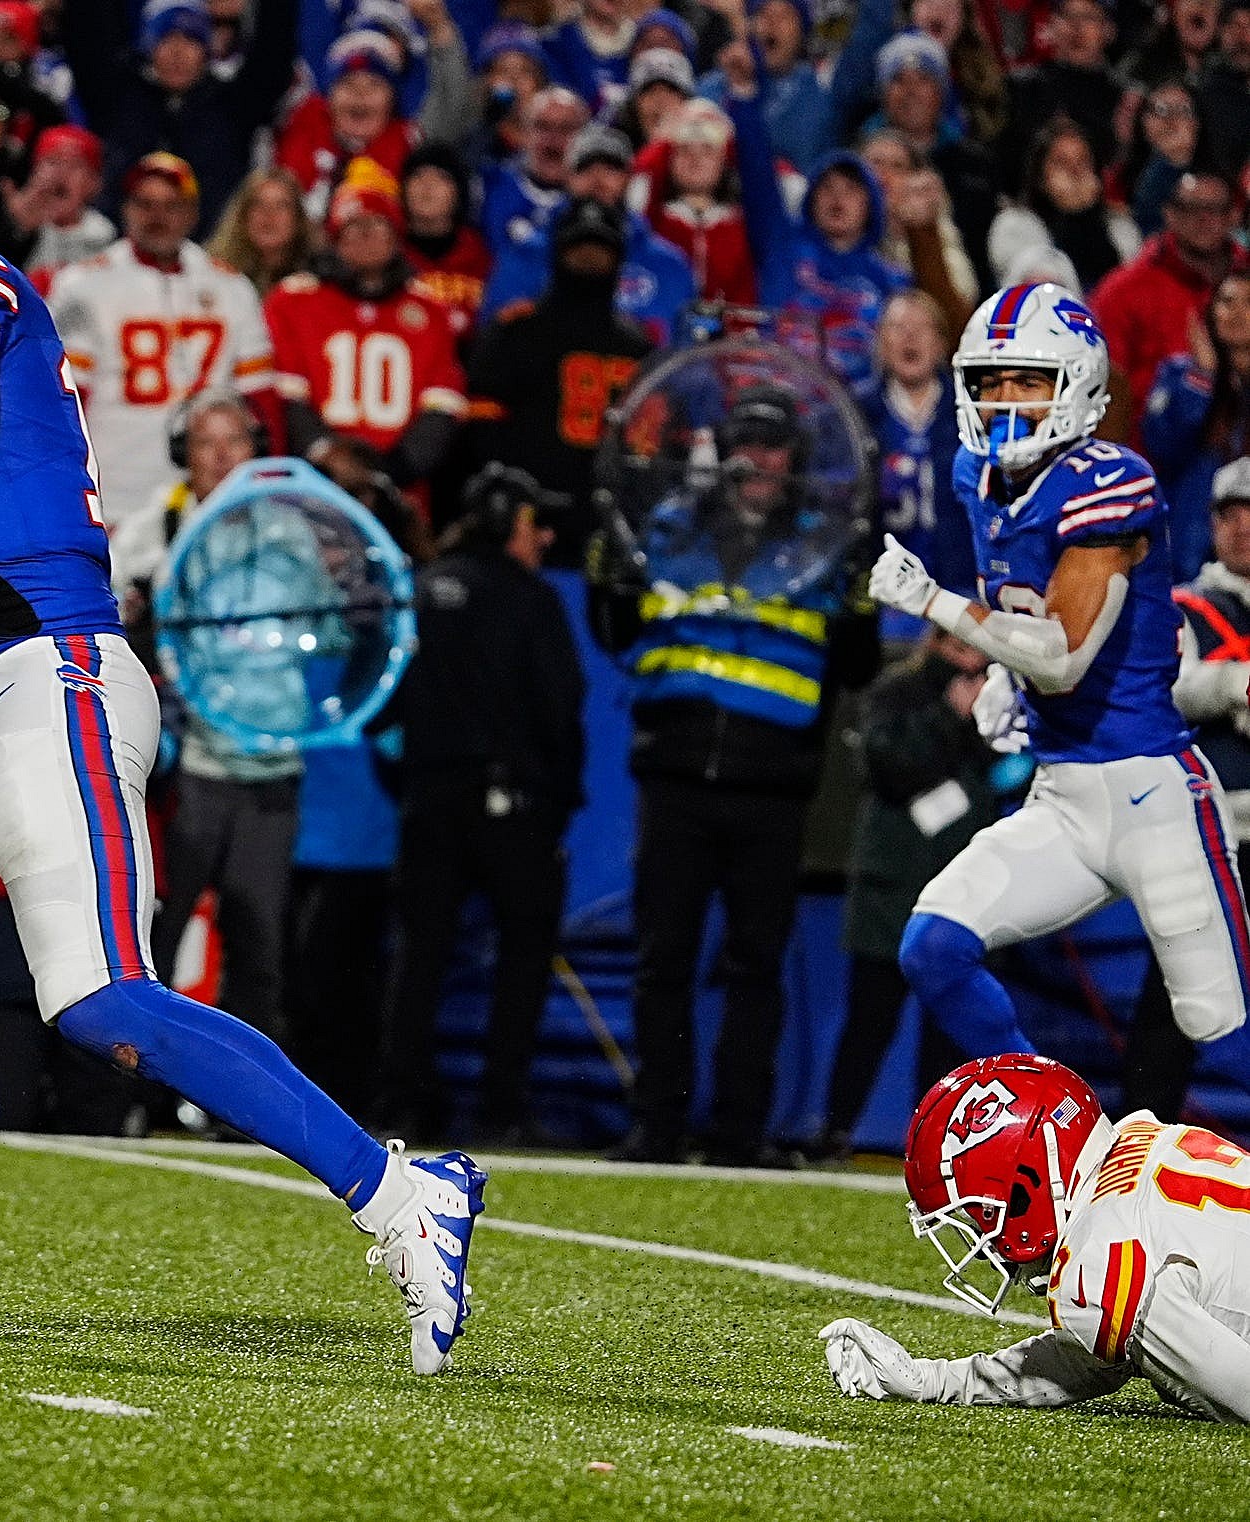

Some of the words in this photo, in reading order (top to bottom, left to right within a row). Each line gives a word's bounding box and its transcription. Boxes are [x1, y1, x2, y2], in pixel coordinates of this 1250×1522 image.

[119, 318, 225, 407] 87
[322, 330, 413, 430] 10
[1063, 443, 1123, 474] 10
[1090, 1120, 1164, 1204] JOHNSO
